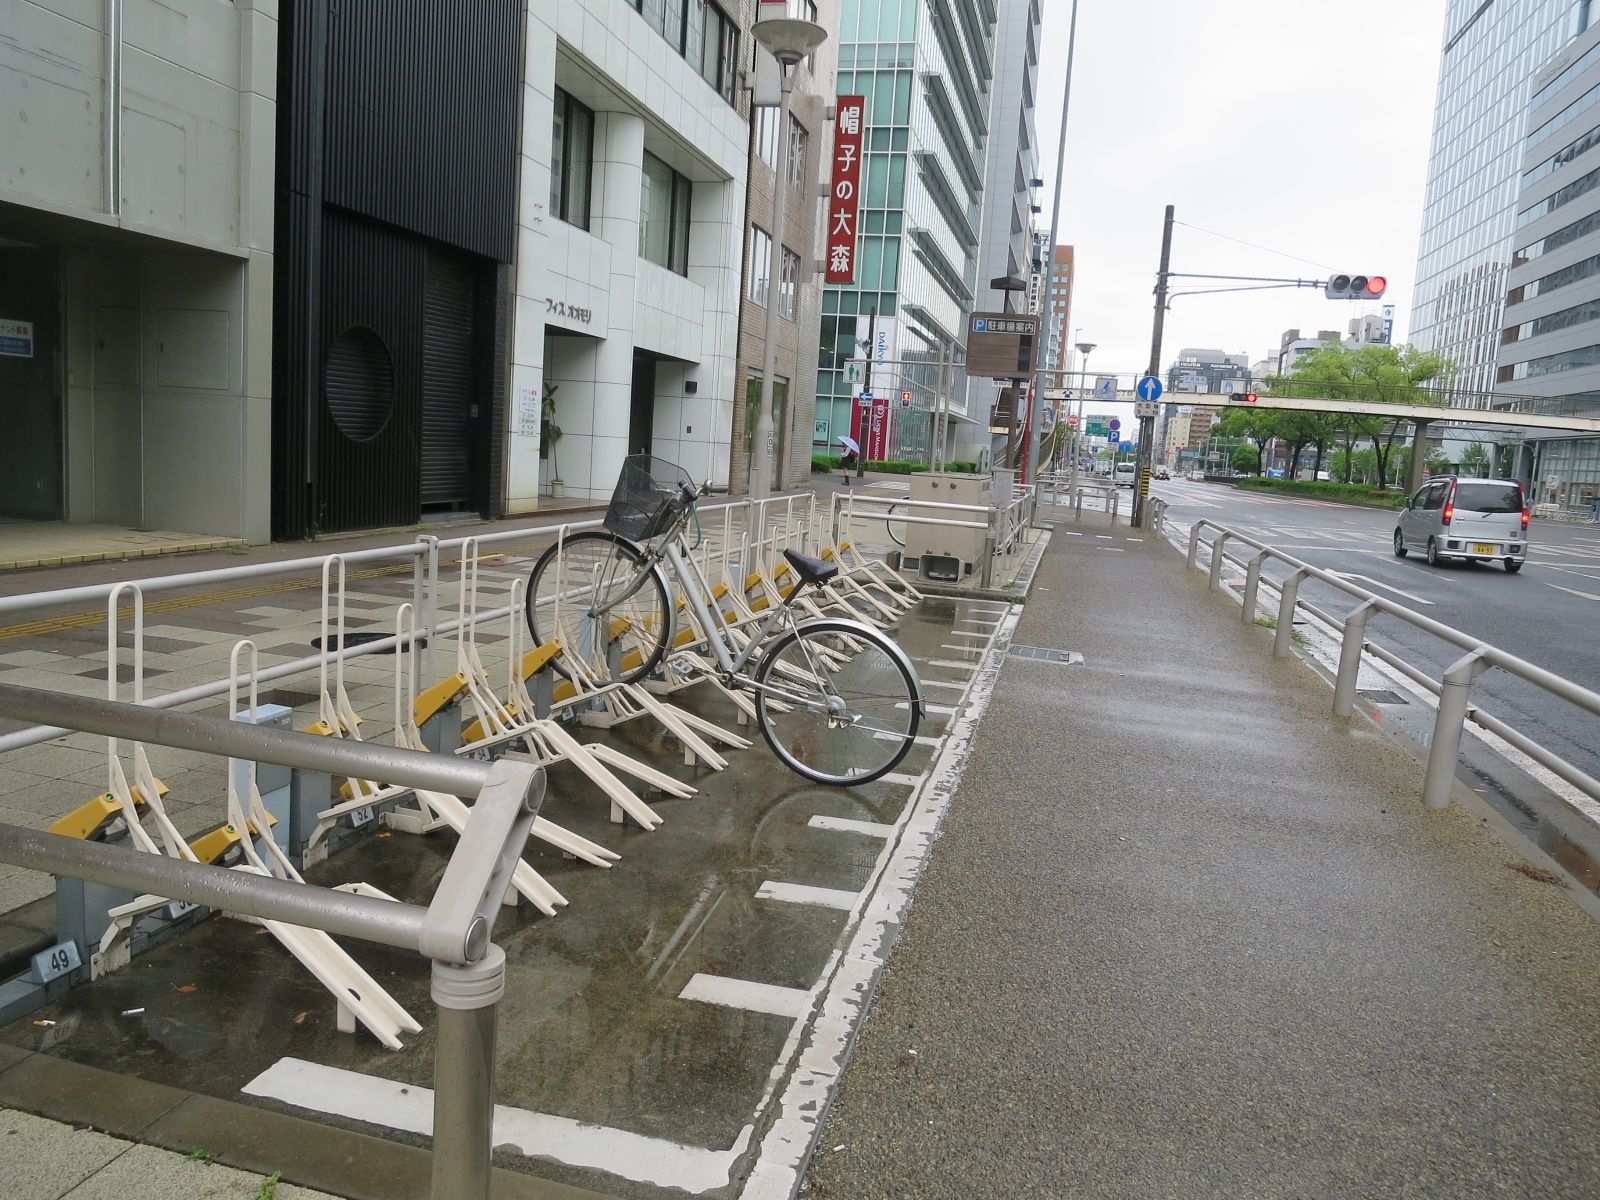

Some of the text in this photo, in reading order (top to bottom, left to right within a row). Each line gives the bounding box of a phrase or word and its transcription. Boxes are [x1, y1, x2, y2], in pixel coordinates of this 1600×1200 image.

[830, 106, 860, 273] 帽子の大森
[51, 949, 69, 971] 49
